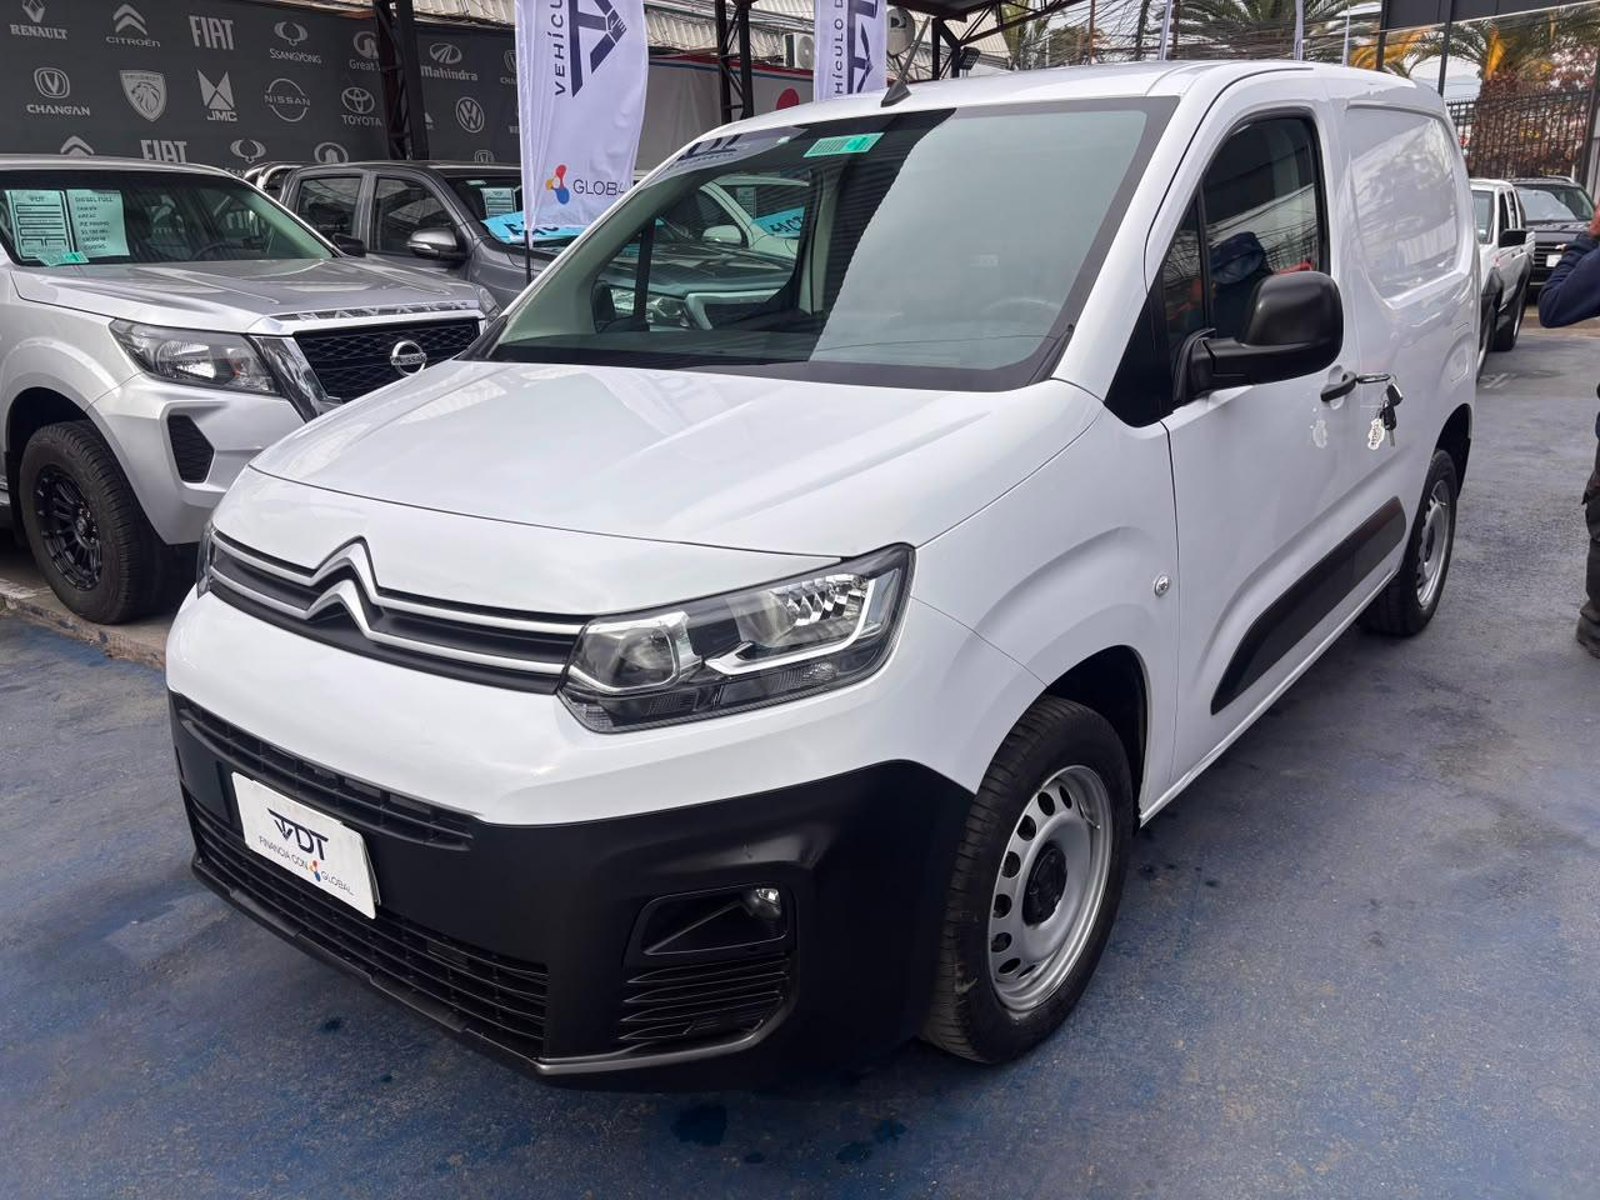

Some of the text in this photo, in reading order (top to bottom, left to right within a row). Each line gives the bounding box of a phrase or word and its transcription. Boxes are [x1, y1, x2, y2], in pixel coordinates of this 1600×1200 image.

[10, 24, 68, 41] RENAULT
[188, 15, 234, 51] FIAT
[269, 48, 322, 64] SSANGYONG
[349, 58, 375, 72] Great
[420, 64, 478, 81] Mahindra
[264, 94, 311, 106] NISSAN
[26, 104, 91, 116] CHANGAN
[207, 110, 238, 121] JMC
[341, 114, 382, 127] TOYOTA
[140, 139, 187, 164] FIAT
[266, 808, 329, 860] VDT
[258, 835, 355, 897] FINANCIA CON GLOBAL
